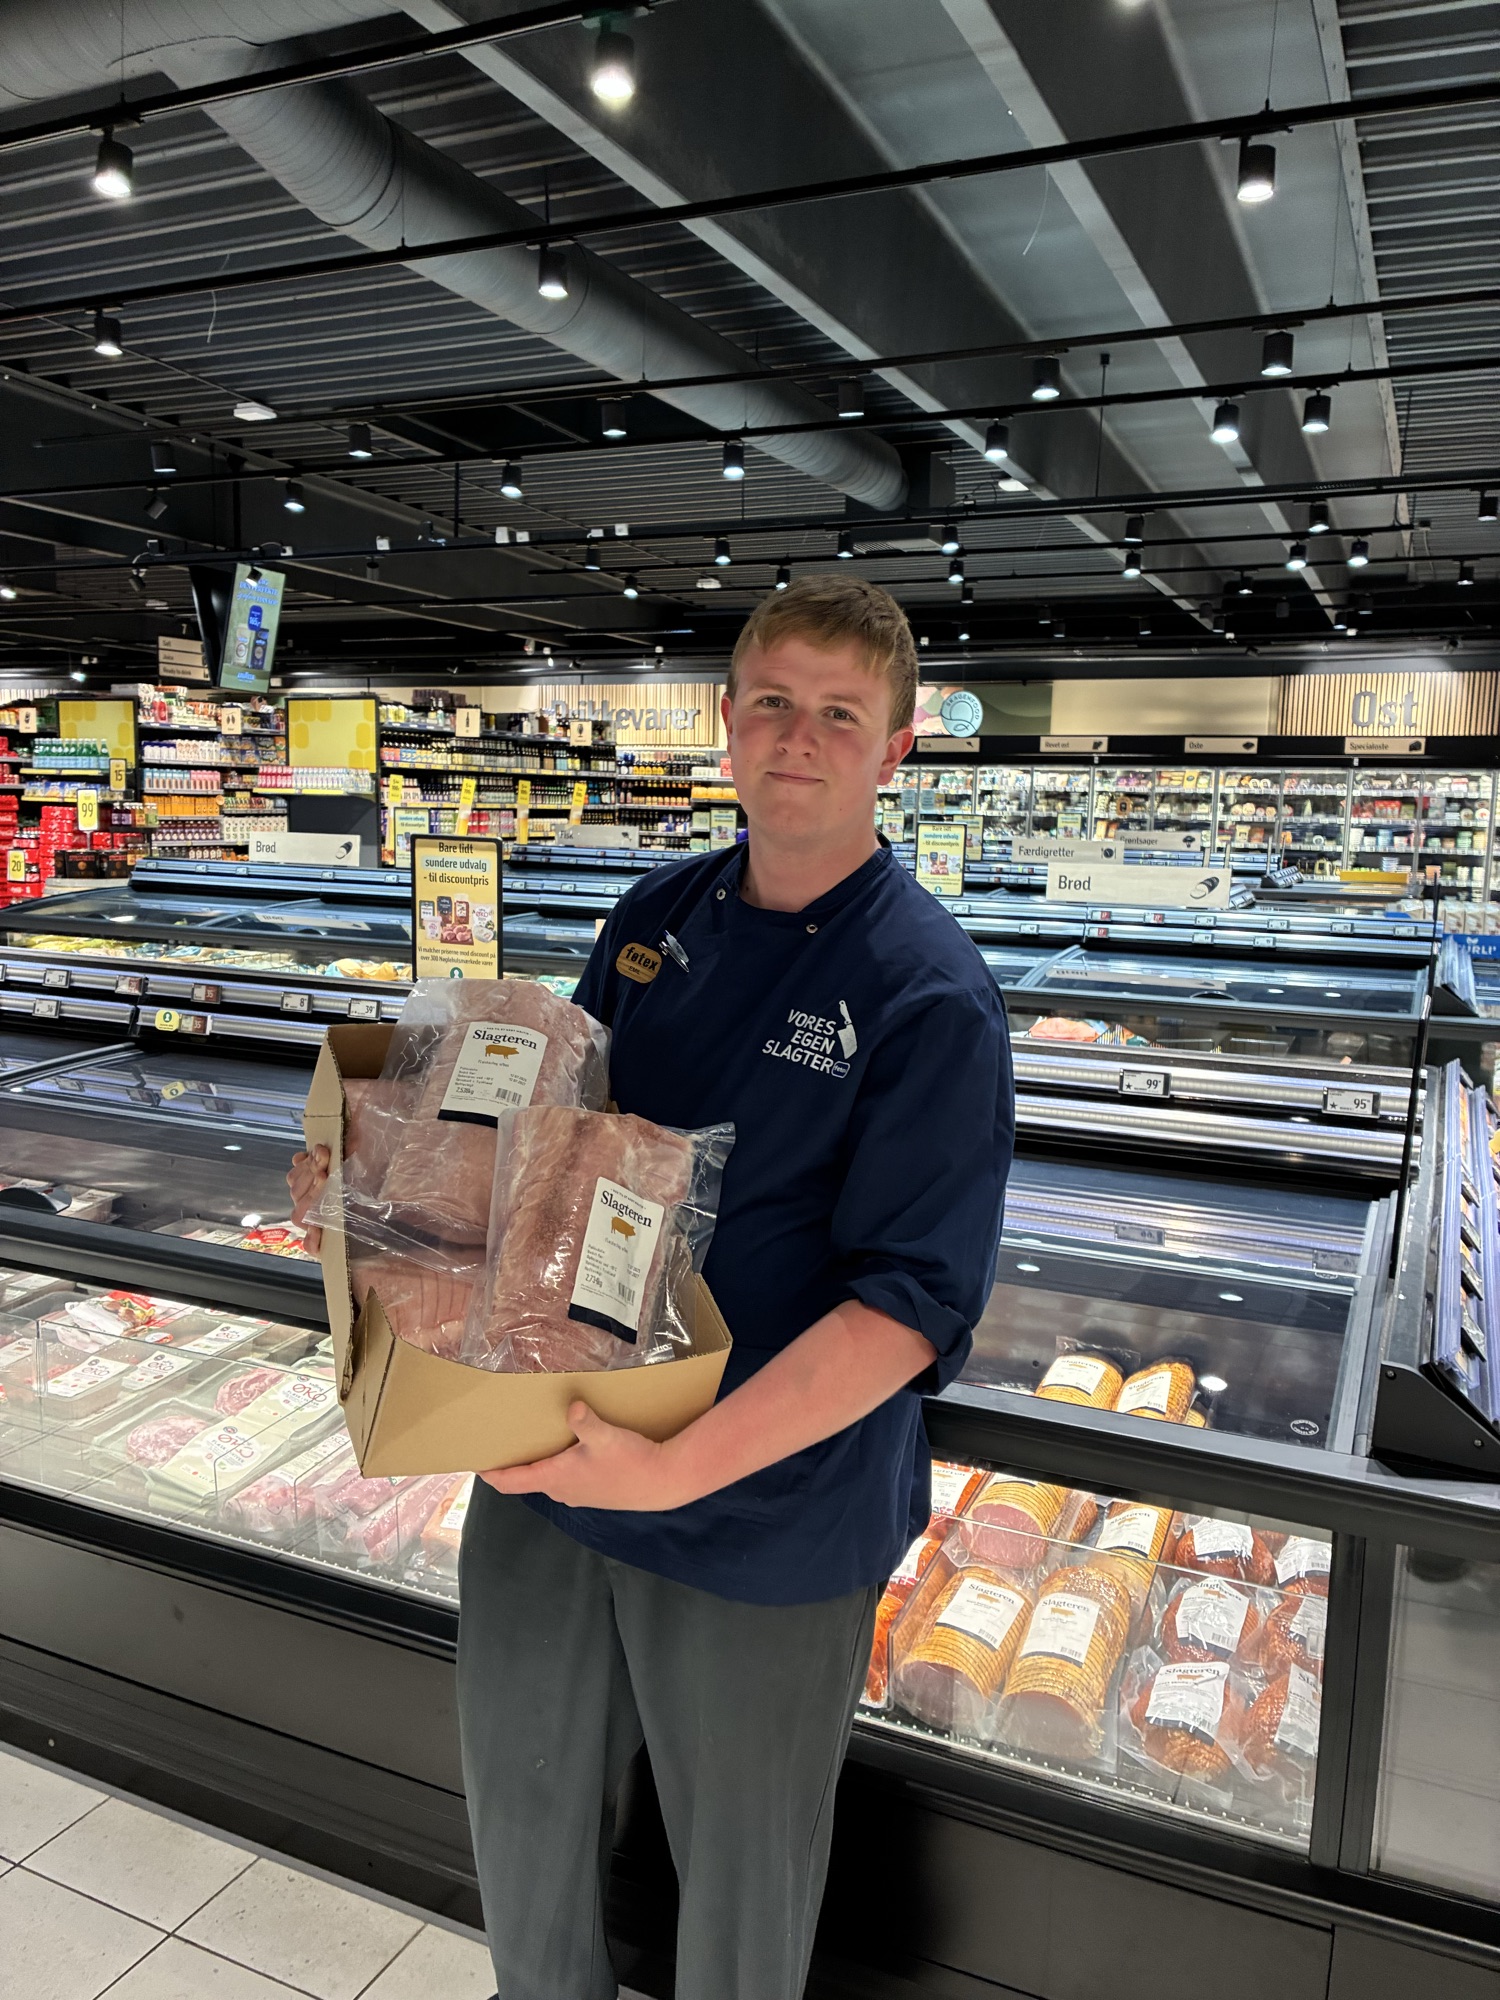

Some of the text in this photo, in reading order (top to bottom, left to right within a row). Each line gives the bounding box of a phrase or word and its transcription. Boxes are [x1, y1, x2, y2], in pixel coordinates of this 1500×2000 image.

[1352, 690, 1418, 727] Ost
[82, 802, 94, 817] 99
[256, 841, 276, 853] Brød
[439, 842, 473, 853] Bare lidt
[1018, 846, 1074, 858] Færdigretter
[12, 860, 21, 872] 20
[425, 859, 487, 872] sundere udvalg
[429, 872, 437, 882] til
[439, 873, 488, 887] discountpris
[1058, 875, 1092, 891] Brød
[625, 946, 658, 971] føtex
[787, 1009, 836, 1035] VORES
[473, 1030, 537, 1050] Slagteren
[791, 1029, 836, 1054] EGEN
[762, 1040, 834, 1074] SLAGTER
[600, 1190, 652, 1227] Slagteren
[968, 1583, 1015, 1605] Slagteren
[1042, 1599, 1090, 1614] Slagteren
[1165, 1668, 1220, 1677] Slagteren
